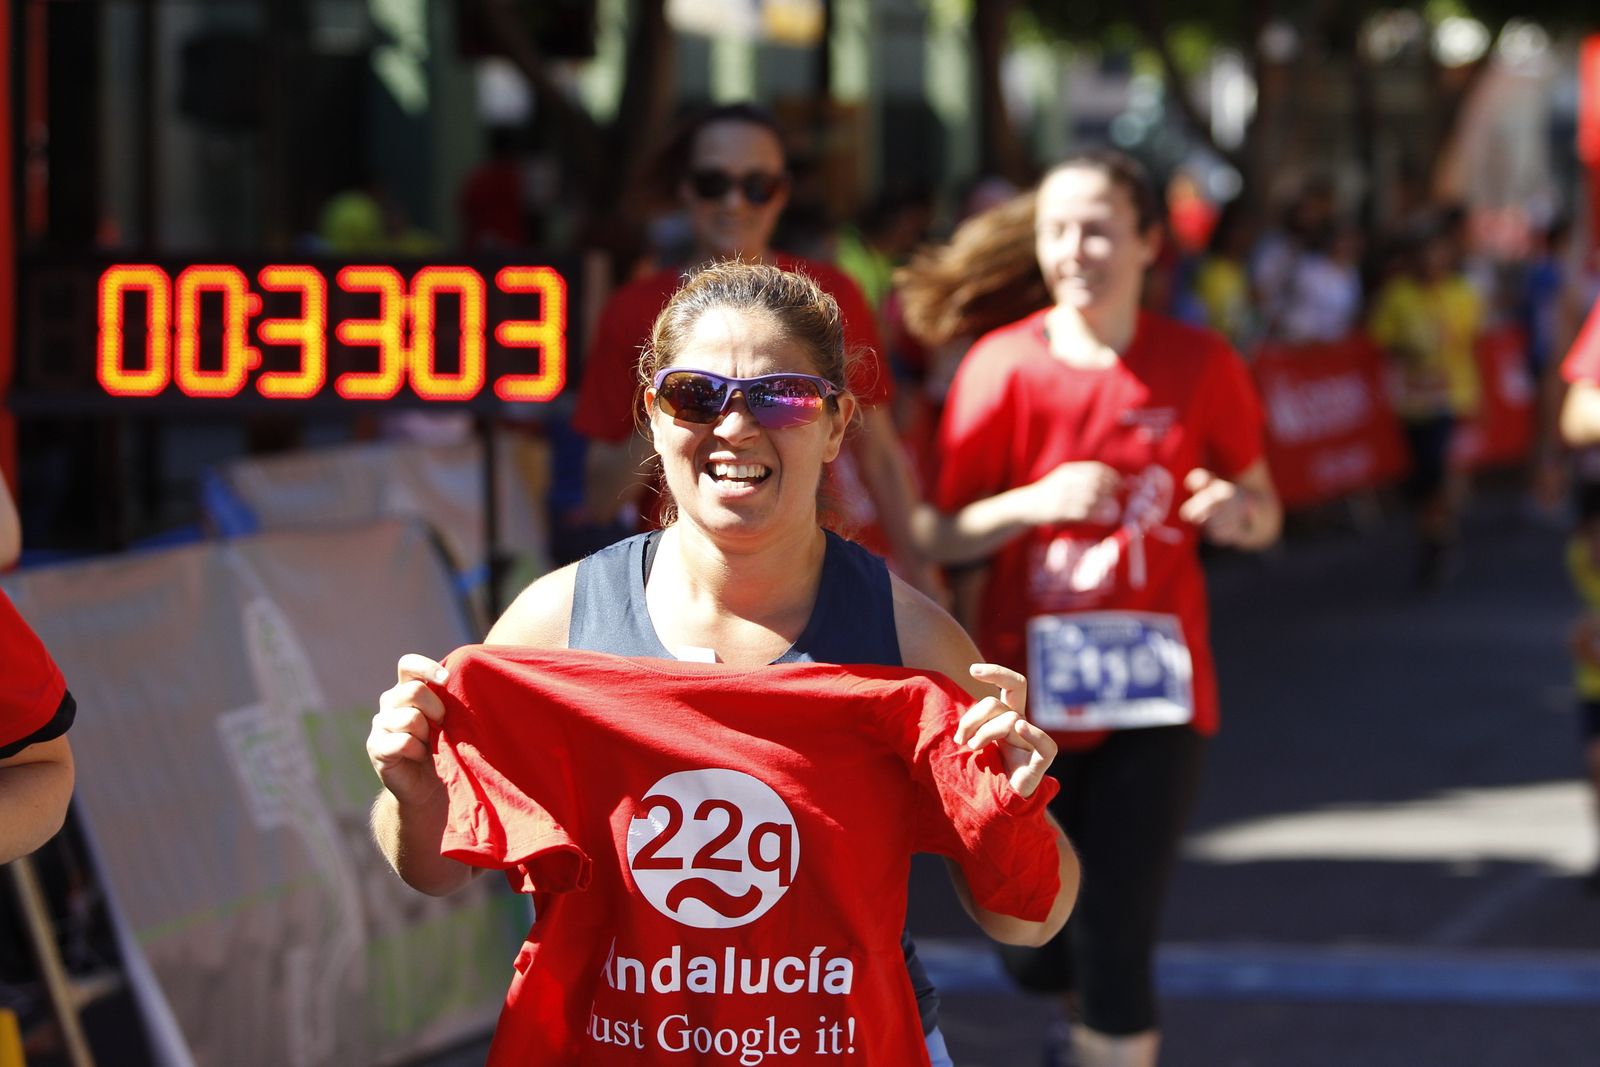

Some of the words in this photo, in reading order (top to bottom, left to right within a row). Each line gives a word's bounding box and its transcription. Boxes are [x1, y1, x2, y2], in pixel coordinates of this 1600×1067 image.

[97, 264, 567, 402] 00:33:03
[631, 794, 793, 887] 22q
[656, 1013, 800, 1067] Google
[815, 1015, 856, 1055] it!
